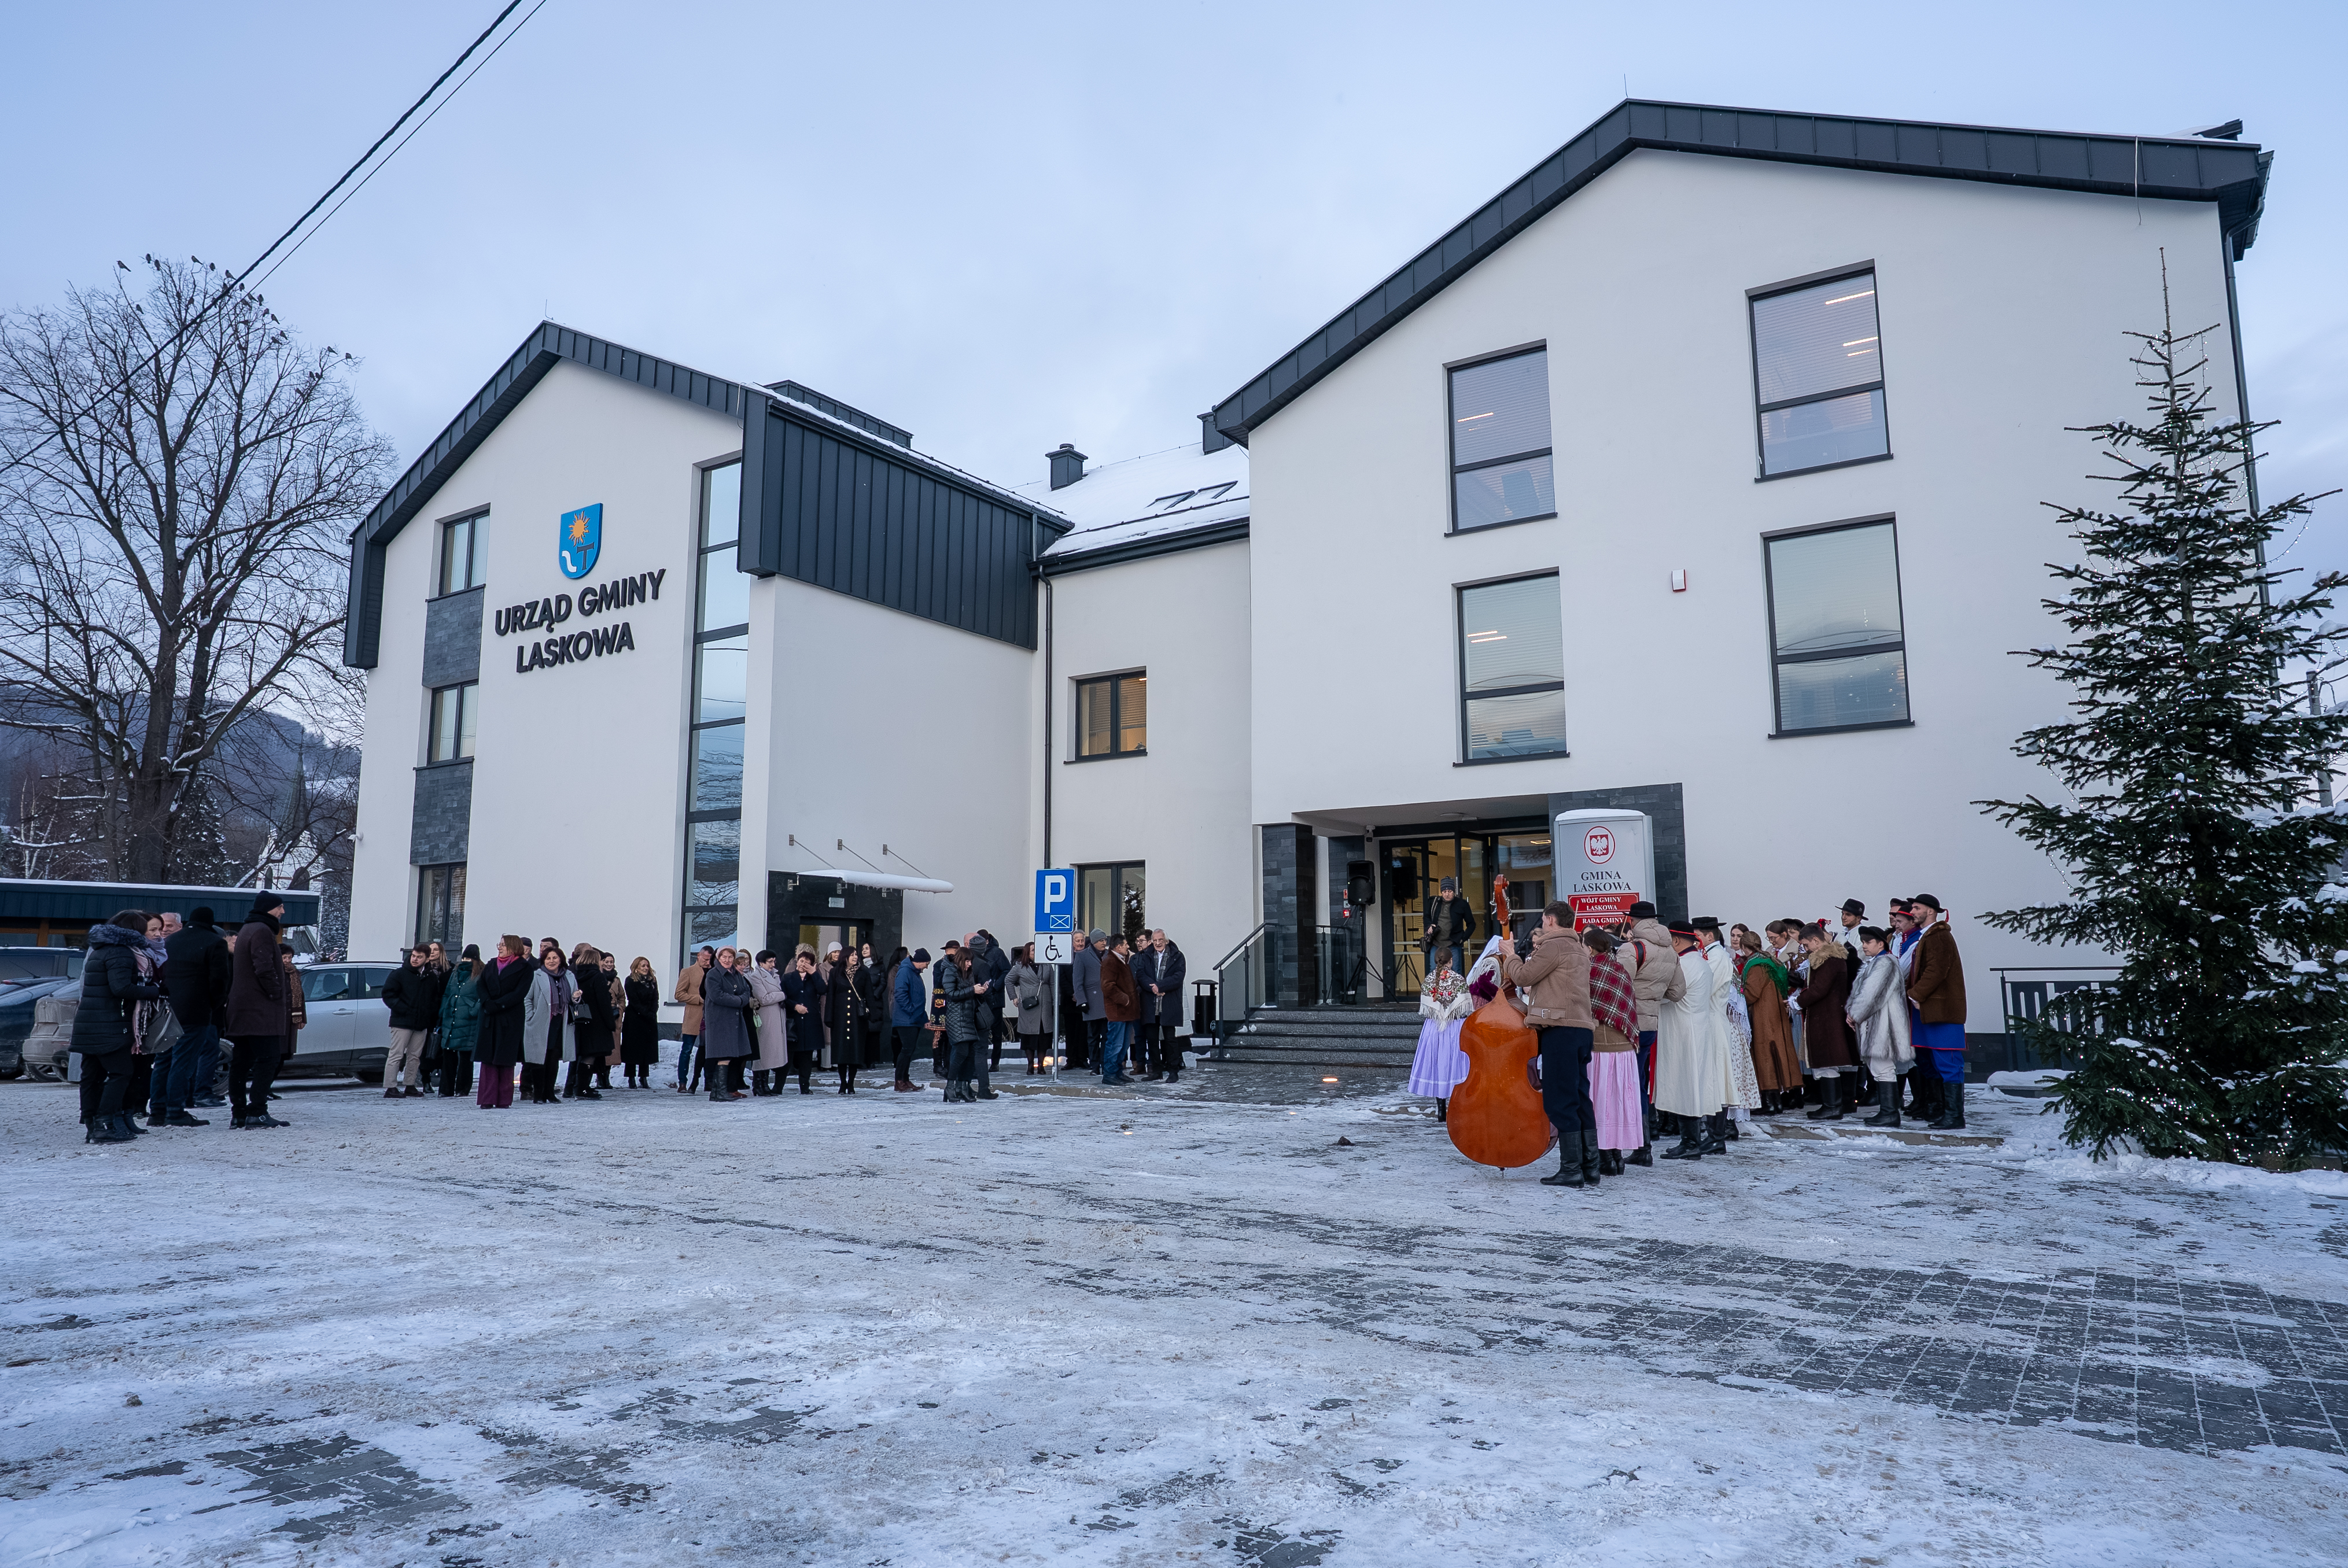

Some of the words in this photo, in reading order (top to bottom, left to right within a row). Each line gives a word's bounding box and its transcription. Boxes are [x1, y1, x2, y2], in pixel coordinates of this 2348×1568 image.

[495, 593, 572, 636] URZĄD
[578, 569, 666, 616] GMINY
[516, 622, 635, 673] LASKOWA
[1044, 875, 1066, 913] P
[1573, 882, 1631, 892] LASKOWA
[1581, 871, 1621, 880] GMINA
